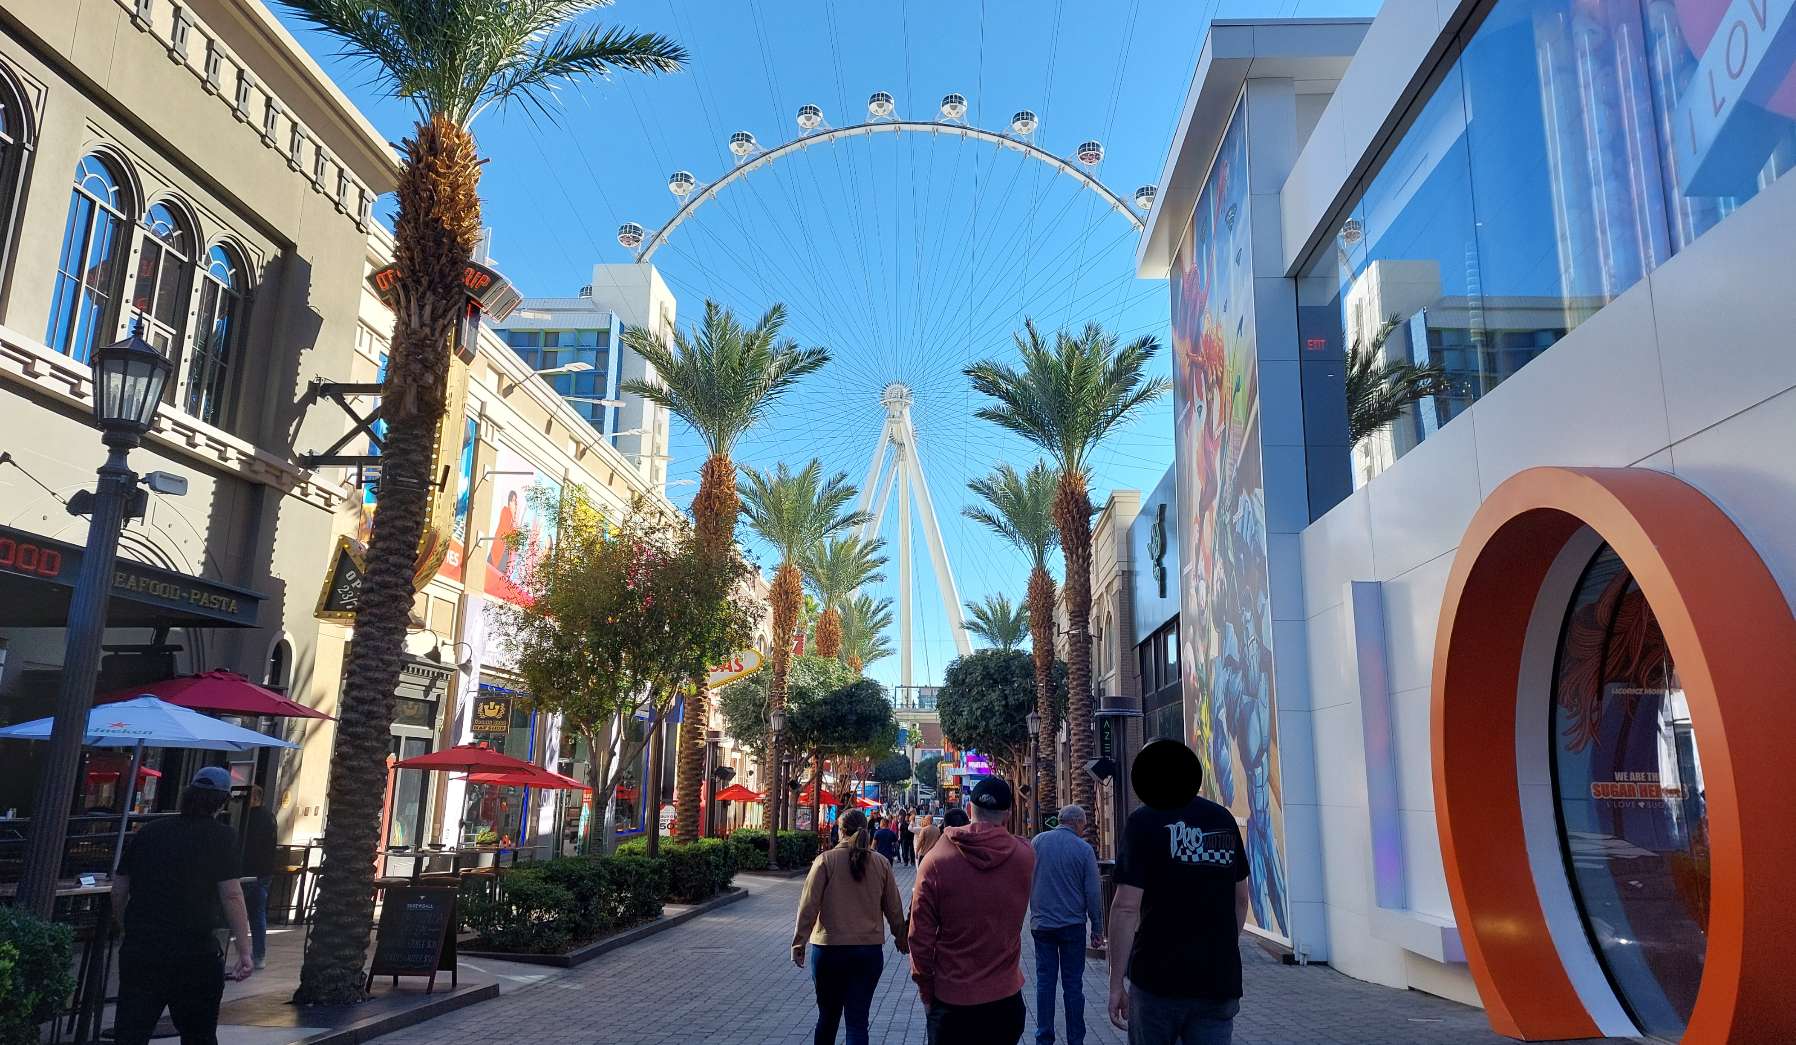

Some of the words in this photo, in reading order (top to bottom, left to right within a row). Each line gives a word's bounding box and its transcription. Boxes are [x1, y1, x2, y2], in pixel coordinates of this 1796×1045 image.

[345, 570, 362, 588] OP
[113, 571, 238, 613] EAFOOD-PASTA
[1614, 771, 1629, 781] WE
[1631, 772, 1645, 781] ARE
[1647, 772, 1661, 781] TH
